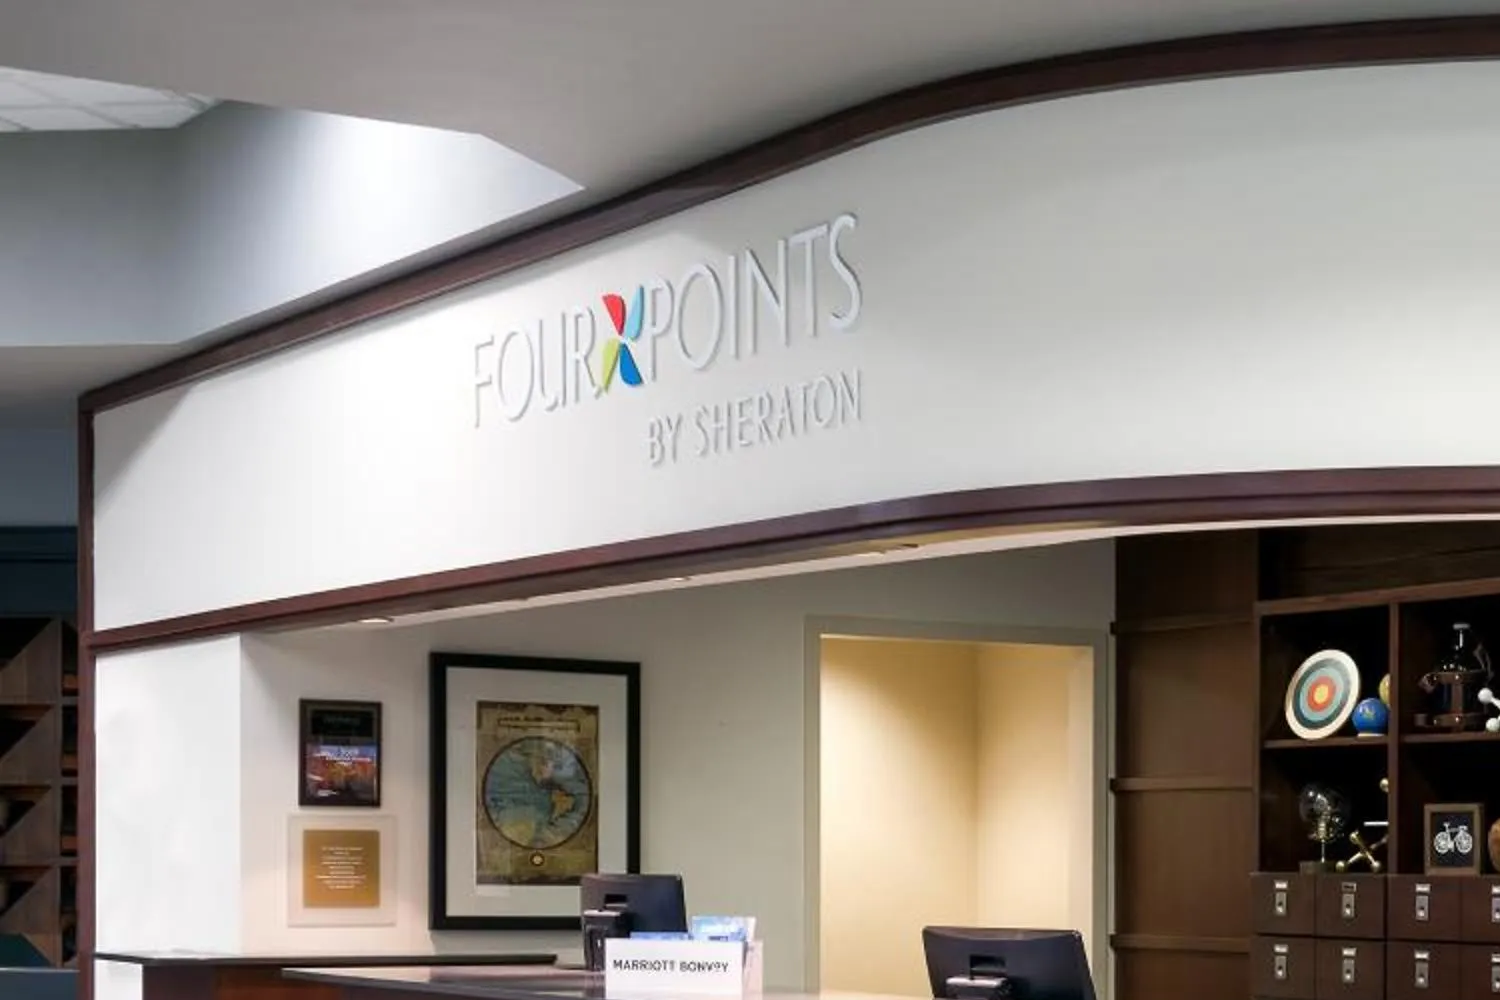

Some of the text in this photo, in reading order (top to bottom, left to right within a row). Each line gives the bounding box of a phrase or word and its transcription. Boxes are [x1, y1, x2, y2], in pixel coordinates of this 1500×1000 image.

[473, 211, 864, 428] FOUR POINTS
[646, 367, 863, 467] BY SHERATON
[612, 958, 675, 972] MARRIOTT
